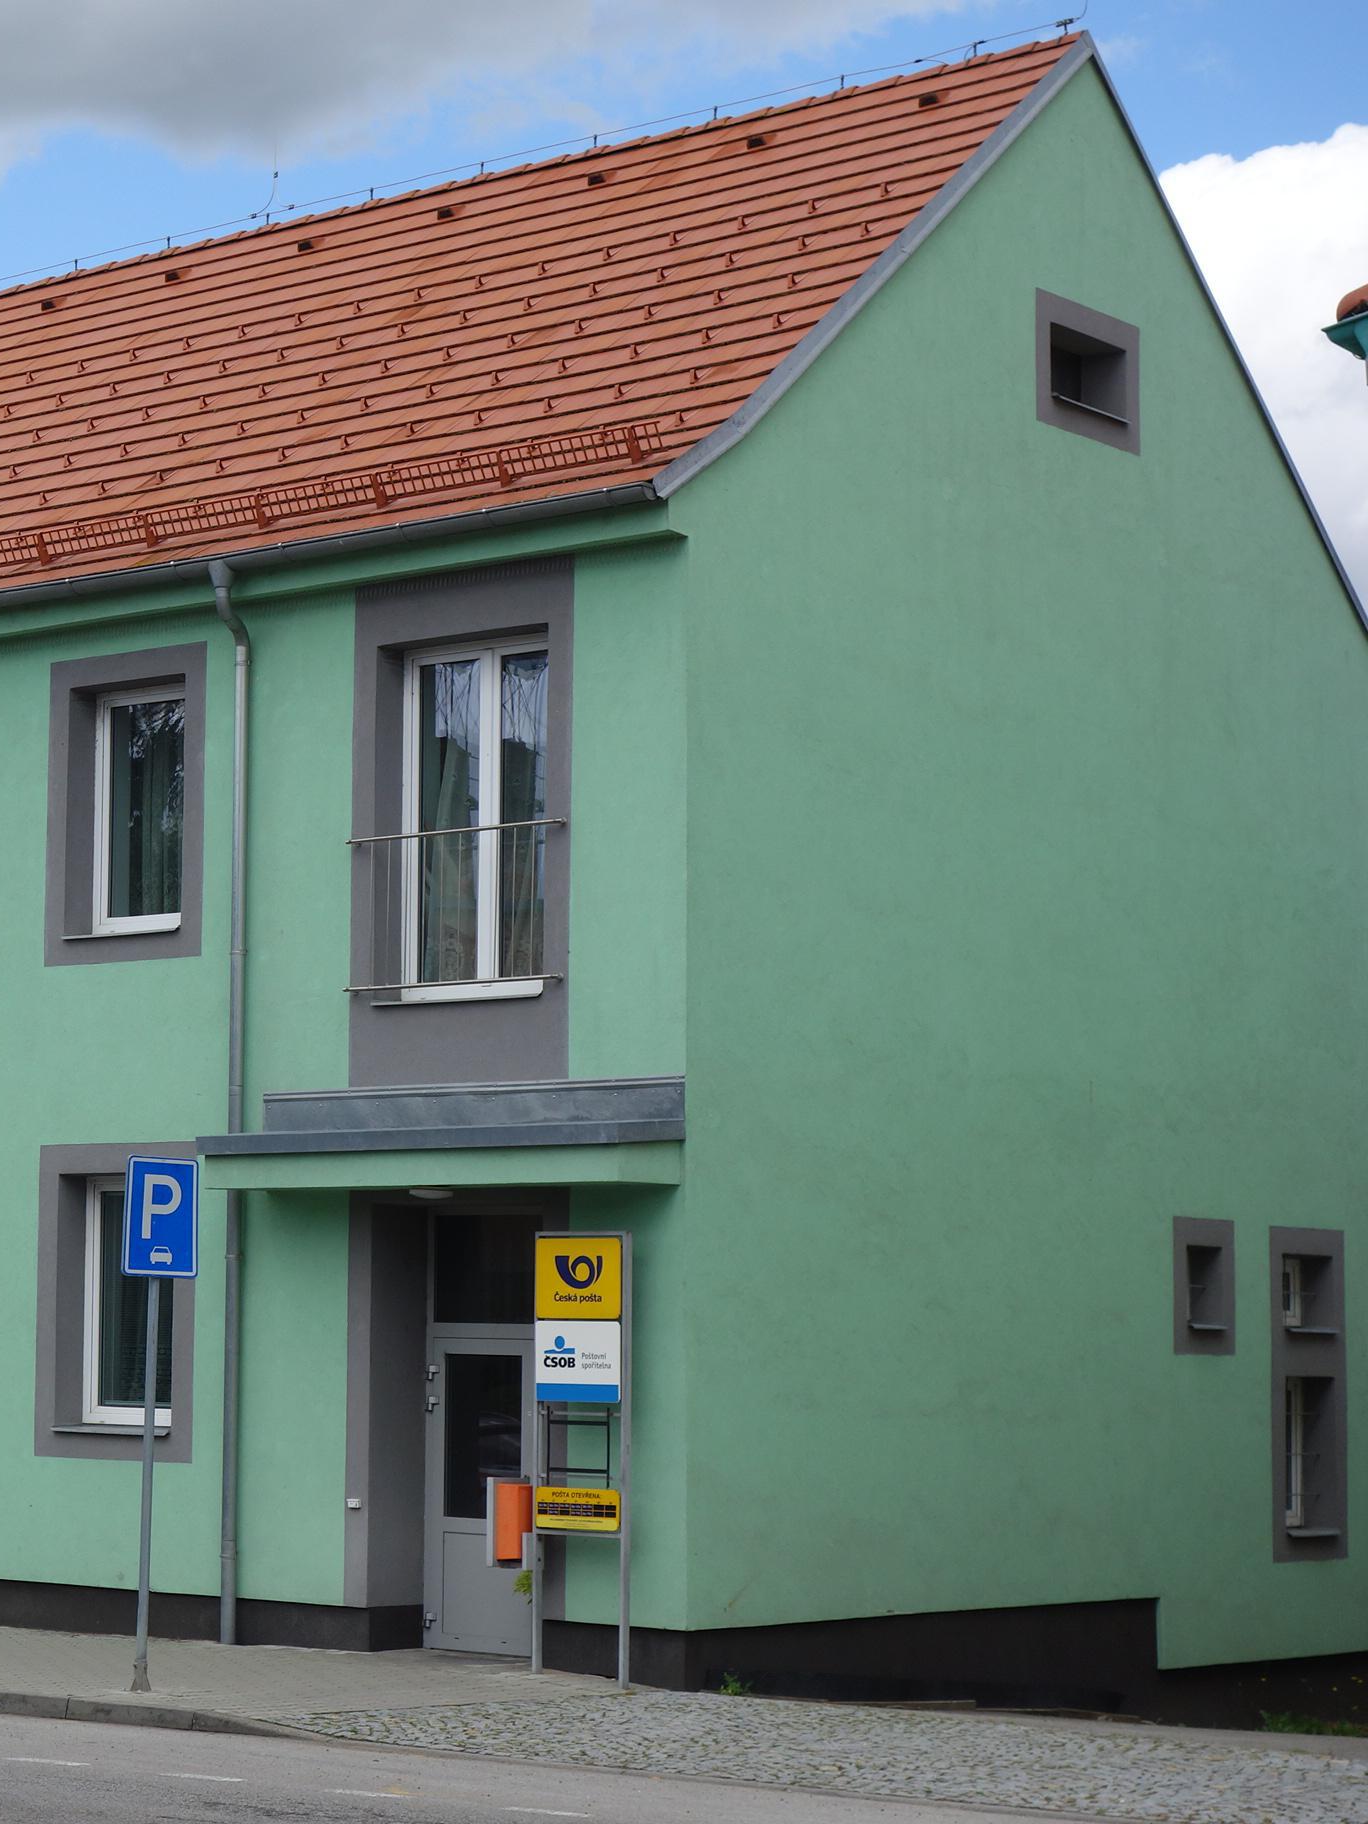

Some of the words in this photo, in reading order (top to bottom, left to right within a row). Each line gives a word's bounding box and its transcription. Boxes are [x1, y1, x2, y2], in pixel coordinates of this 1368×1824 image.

[142, 1173, 182, 1239] P
[554, 1291, 578, 1302] Česká
[579, 1292, 602, 1304] pošta
[543, 1355, 576, 1368] ČSOB
[581, 1352, 607, 1360] Poštovní
[581, 1361, 612, 1370] spořitelna
[552, 1490, 569, 1498] POŠTA
